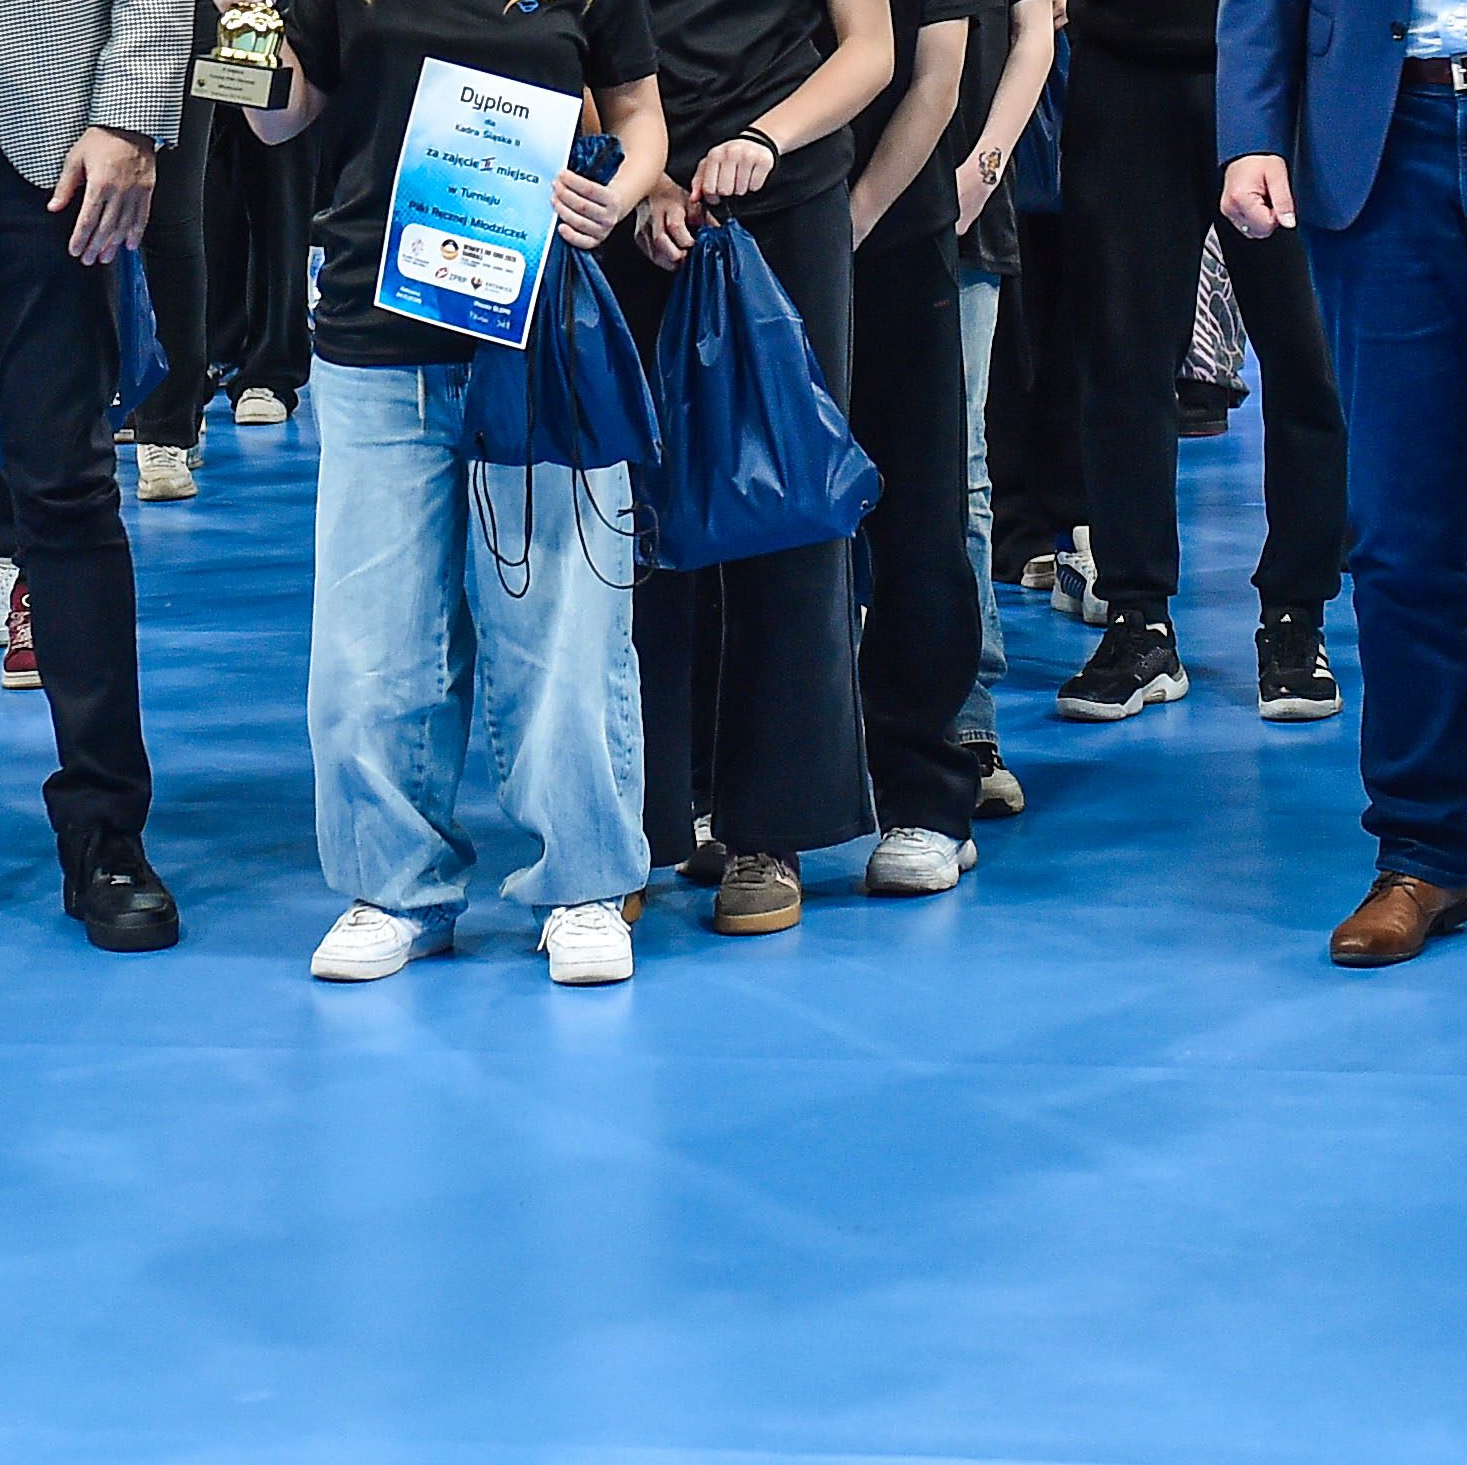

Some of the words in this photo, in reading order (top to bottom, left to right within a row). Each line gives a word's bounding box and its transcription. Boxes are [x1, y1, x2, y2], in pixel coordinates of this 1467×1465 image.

[459, 86, 530, 119] Dyplom
[426, 147, 439, 158] za
[442, 152, 480, 169] zajęcie
[496, 165, 540, 184] miejsca
[461, 187, 501, 206] Turnieju
